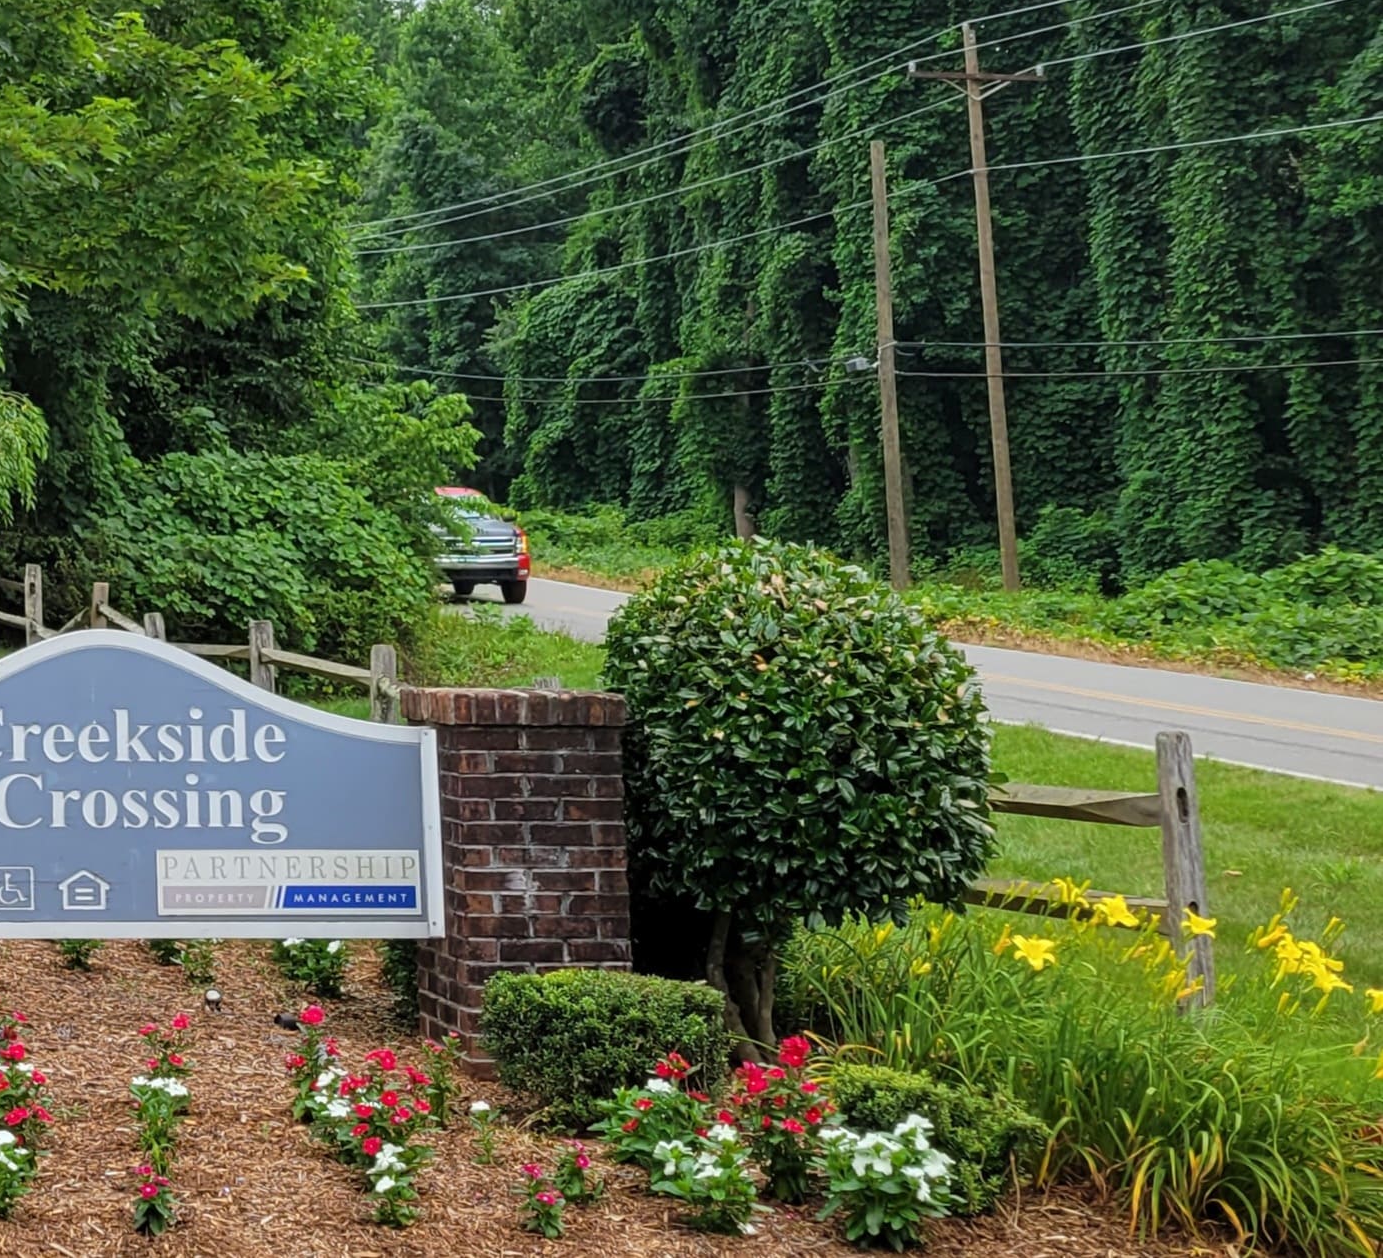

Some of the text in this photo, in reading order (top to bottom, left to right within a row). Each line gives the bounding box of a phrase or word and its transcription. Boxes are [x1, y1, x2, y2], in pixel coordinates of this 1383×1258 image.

[161, 855, 417, 880] PARTNERSHIP
[174, 893, 409, 903] PROPERTY MANAGEMENT
